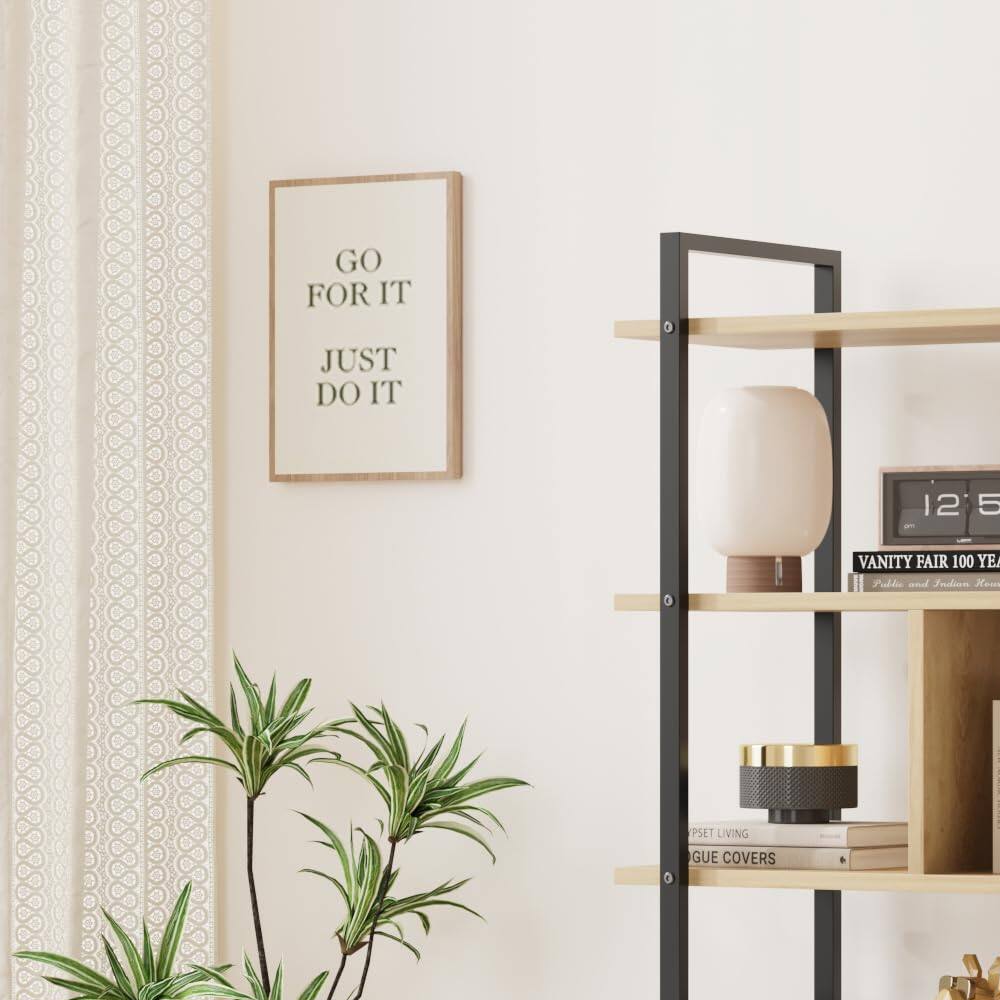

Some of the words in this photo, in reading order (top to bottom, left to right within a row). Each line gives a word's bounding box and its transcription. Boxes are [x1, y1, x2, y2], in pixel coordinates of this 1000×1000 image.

[335, 249, 382, 274] GO
[306, 282, 371, 308] FOR
[379, 279, 412, 306] IT
[320, 347, 397, 373] JUST
[316, 381, 361, 406] DO
[370, 380, 402, 405] IT
[858, 554, 914, 570] VANITY
[916, 554, 949, 569] FAIR
[952, 554, 974, 569] 100
[872, 578, 905, 589] Public
[908, 578, 929, 588] and
[933, 578, 970, 588] Indian
[717, 829, 749, 839] LIVING
[722, 851, 776, 865] COVERS
